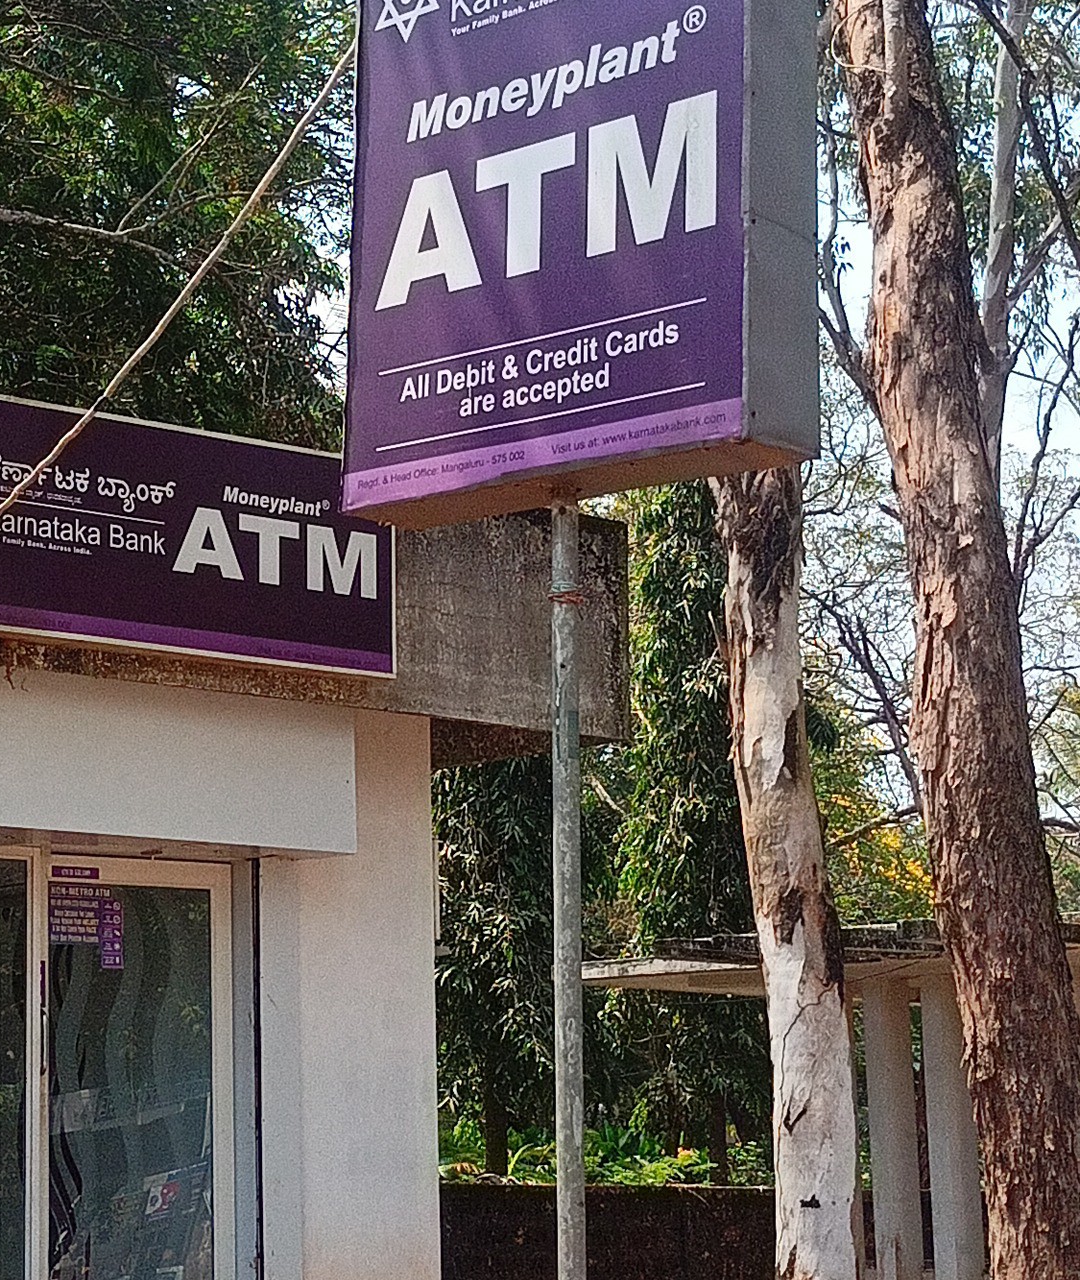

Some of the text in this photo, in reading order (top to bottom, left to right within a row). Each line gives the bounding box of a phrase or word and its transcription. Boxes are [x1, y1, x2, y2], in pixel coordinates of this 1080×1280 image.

[451, 24, 471, 37] Your
[471, 11, 500, 30] Family
[375, 89, 718, 311] ATM
[400, 320, 679, 402] All Debit & Credit Cards
[459, 362, 610, 417] are accepted
[551, 442, 572, 455] Visit
[573, 439, 586, 451] us
[390, 471, 412, 483] Head
[491, 453, 508, 465] 575
[508, 450, 526, 461] 002
[97, 475, 176, 513] ಬ್ಯಾಂಕ್
[109, 523, 166, 556] Bank
[172, 506, 378, 601] ATM
[94, 888, 111, 898] ATM
